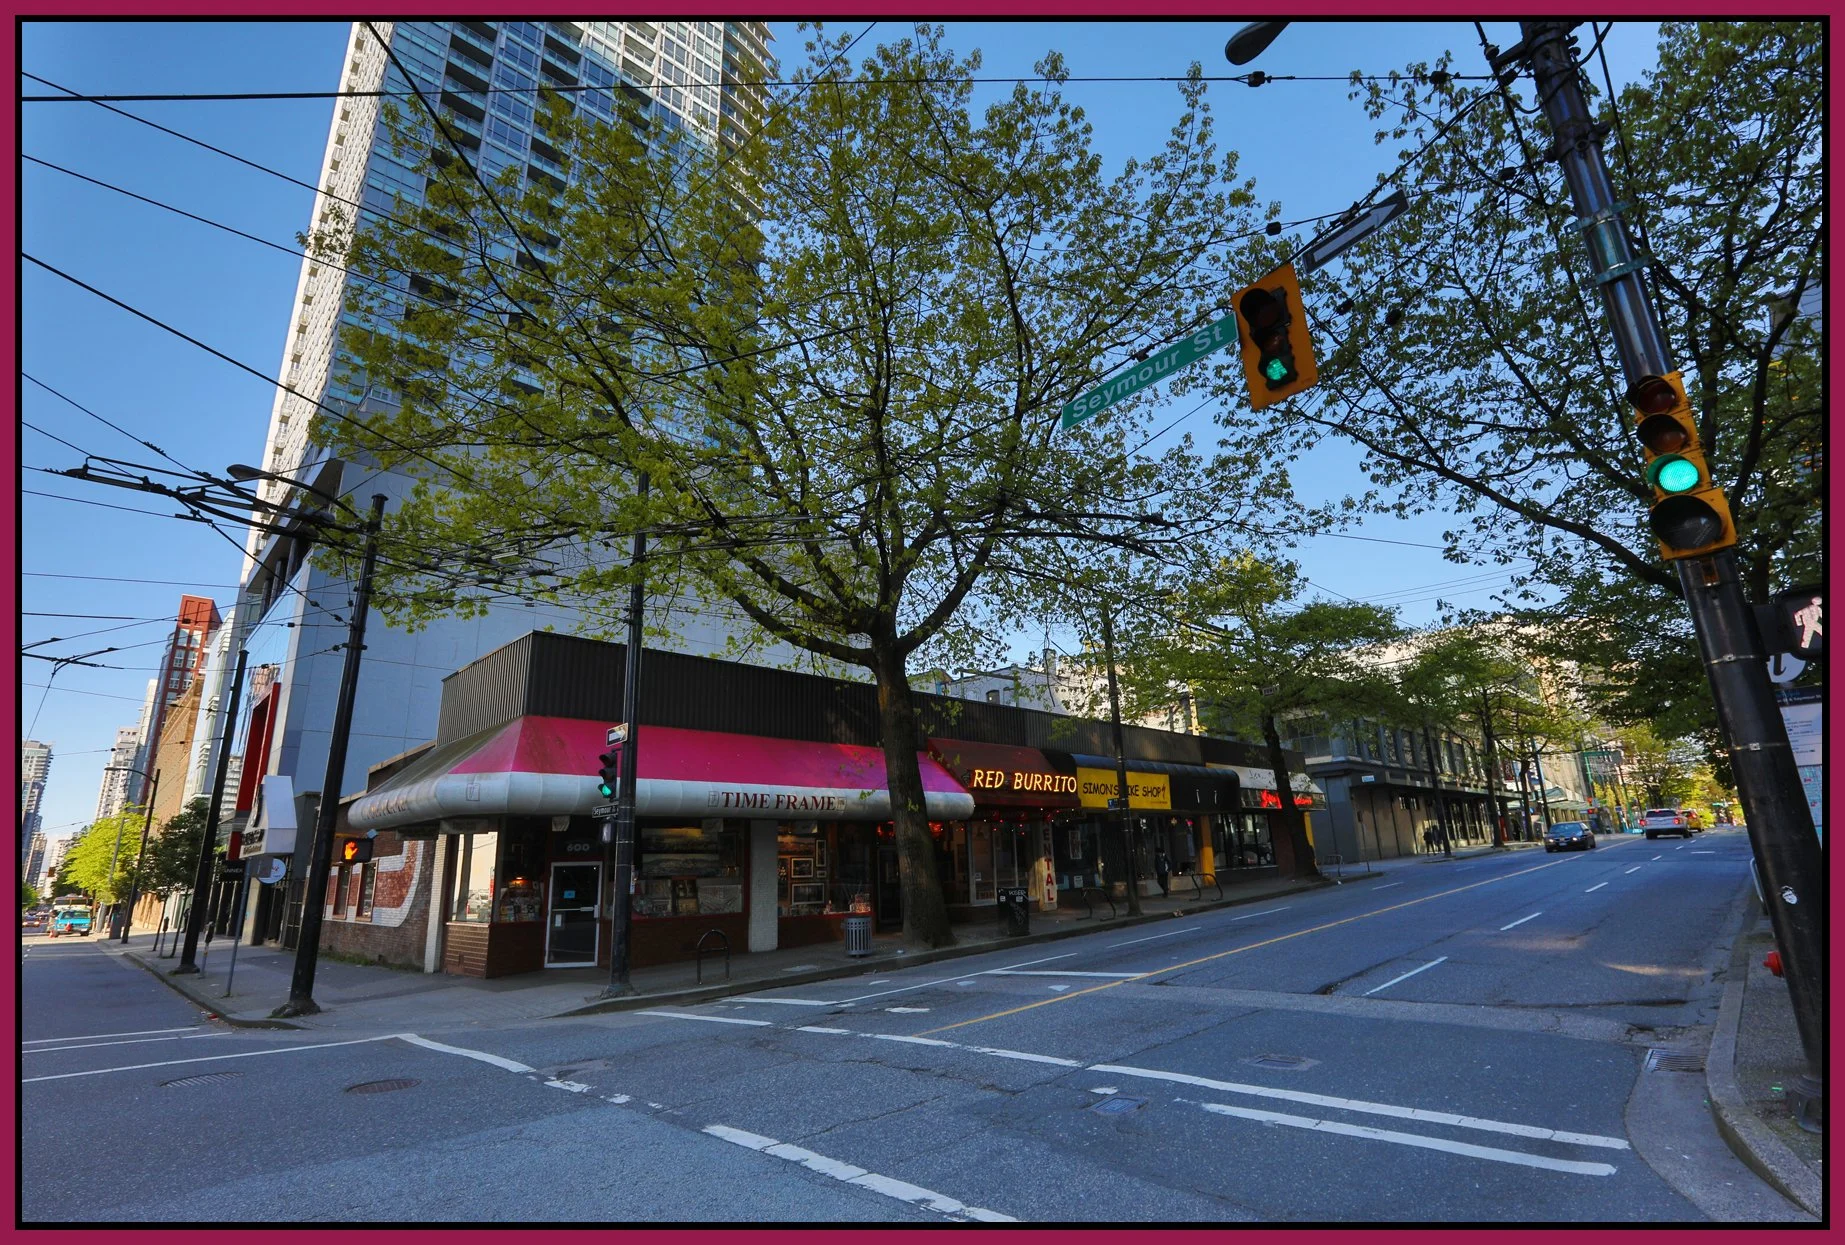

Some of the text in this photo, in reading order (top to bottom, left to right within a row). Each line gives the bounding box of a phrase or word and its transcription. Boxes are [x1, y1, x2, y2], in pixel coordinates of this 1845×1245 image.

[1072, 324, 1224, 418] Seymour St
[973, 769, 1077, 793] RED BURRITO
[1082, 782, 1161, 798] SIMON'S IKE SHOP
[592, 806, 612, 816] Seymour
[722, 792, 770, 809] TIME
[774, 794, 836, 811] FRAME
[567, 843, 590, 852] 600
[1042, 816, 1054, 902] ENTAL
